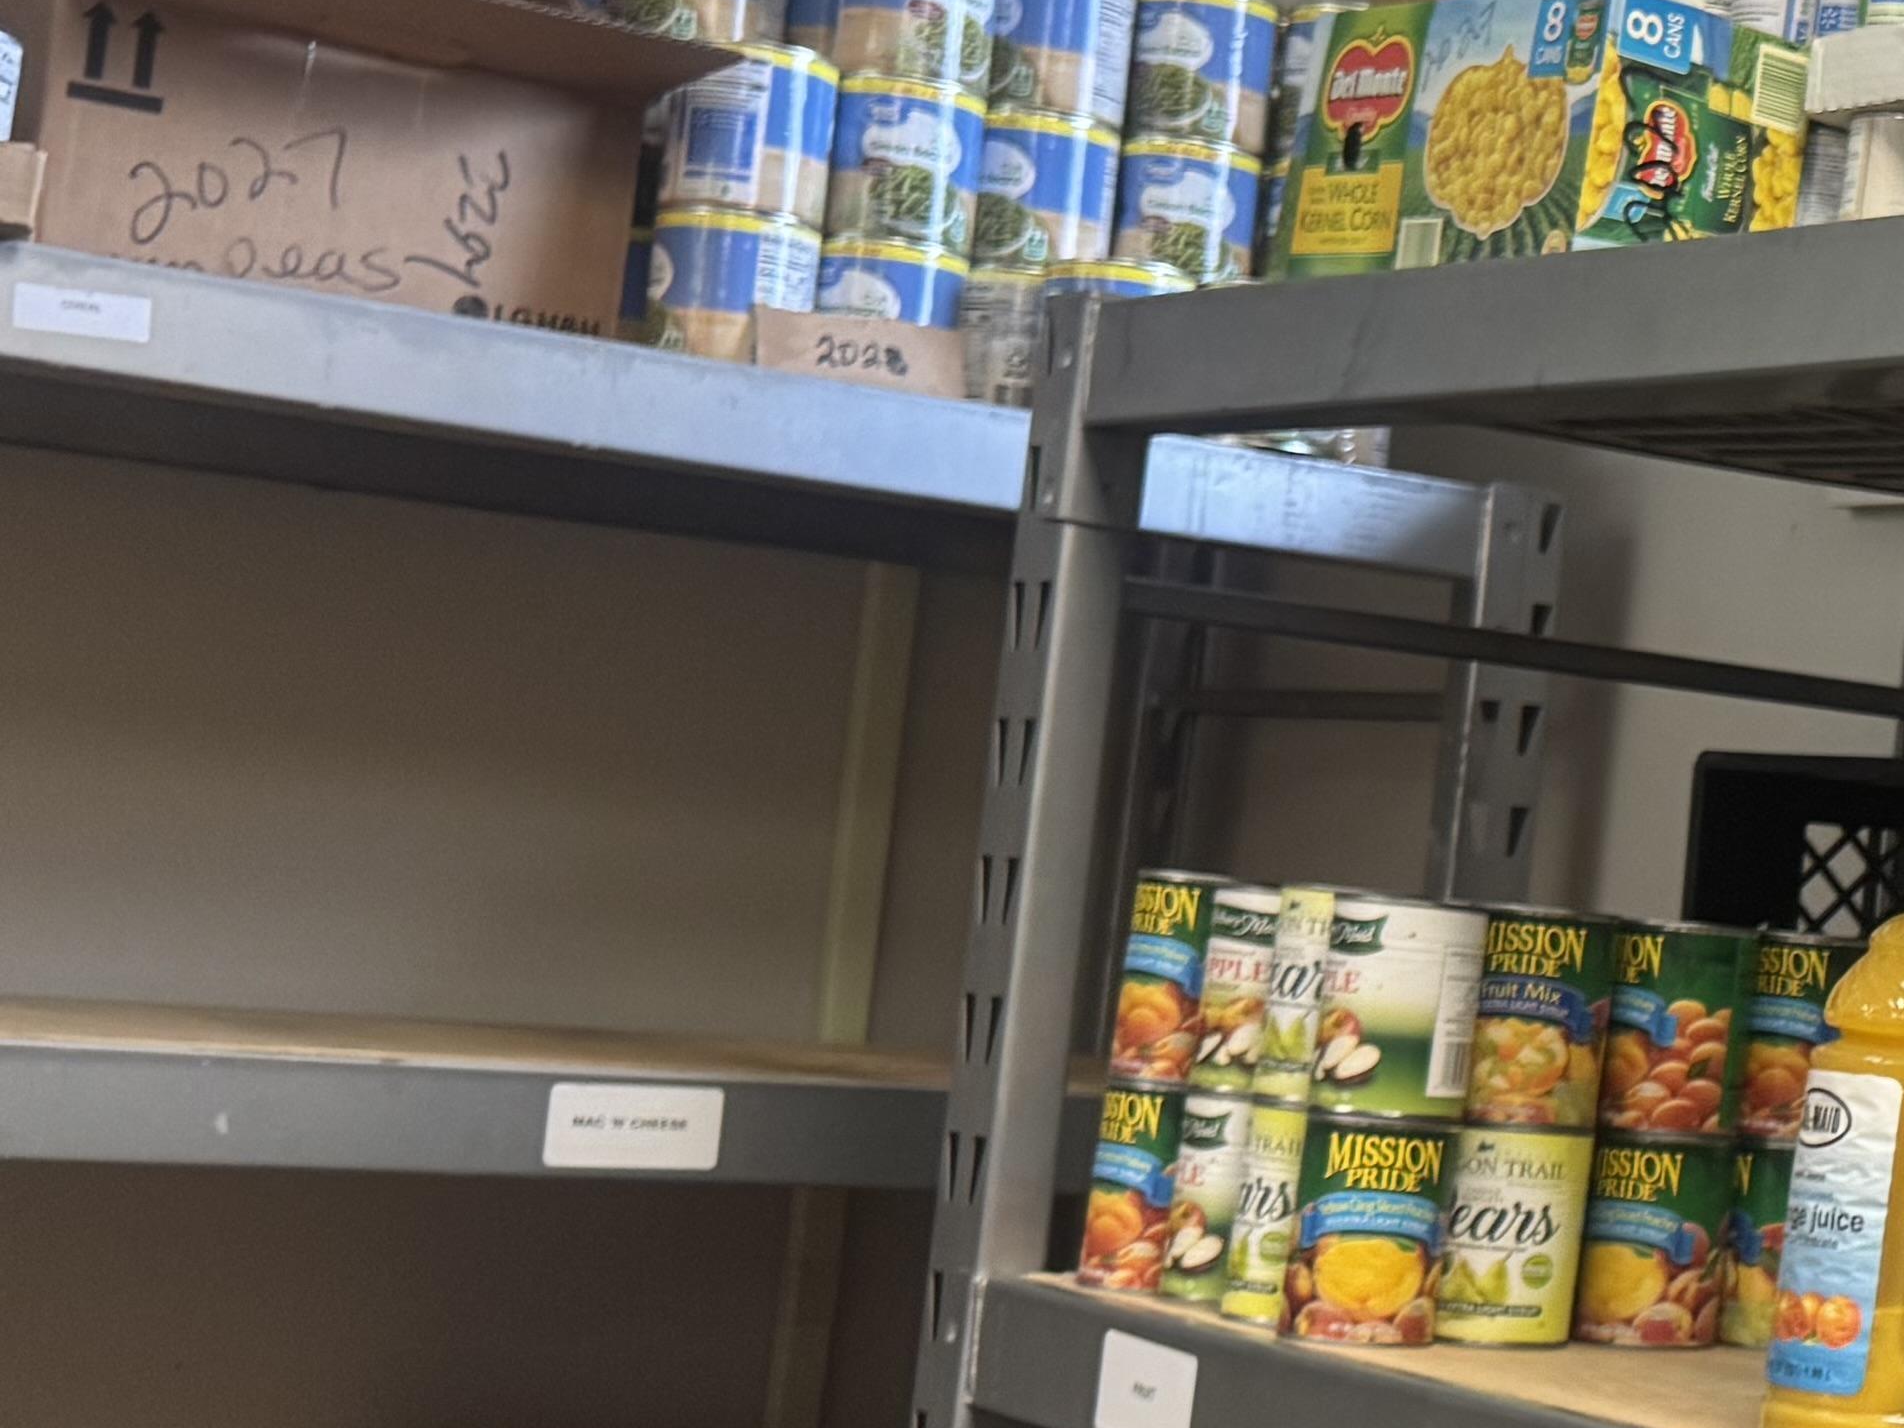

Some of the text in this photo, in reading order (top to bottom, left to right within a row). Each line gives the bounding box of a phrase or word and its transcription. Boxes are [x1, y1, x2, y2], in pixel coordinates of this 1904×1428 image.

[1627, 12, 1664, 46] 8
[1663, 12, 1685, 60] CANS
[130, 126, 349, 246] 2027
[1326, 1132, 1445, 1178] MISSION
[1345, 1166, 1423, 1192] PRIDE
[1810, 1208, 1864, 1238] juice
